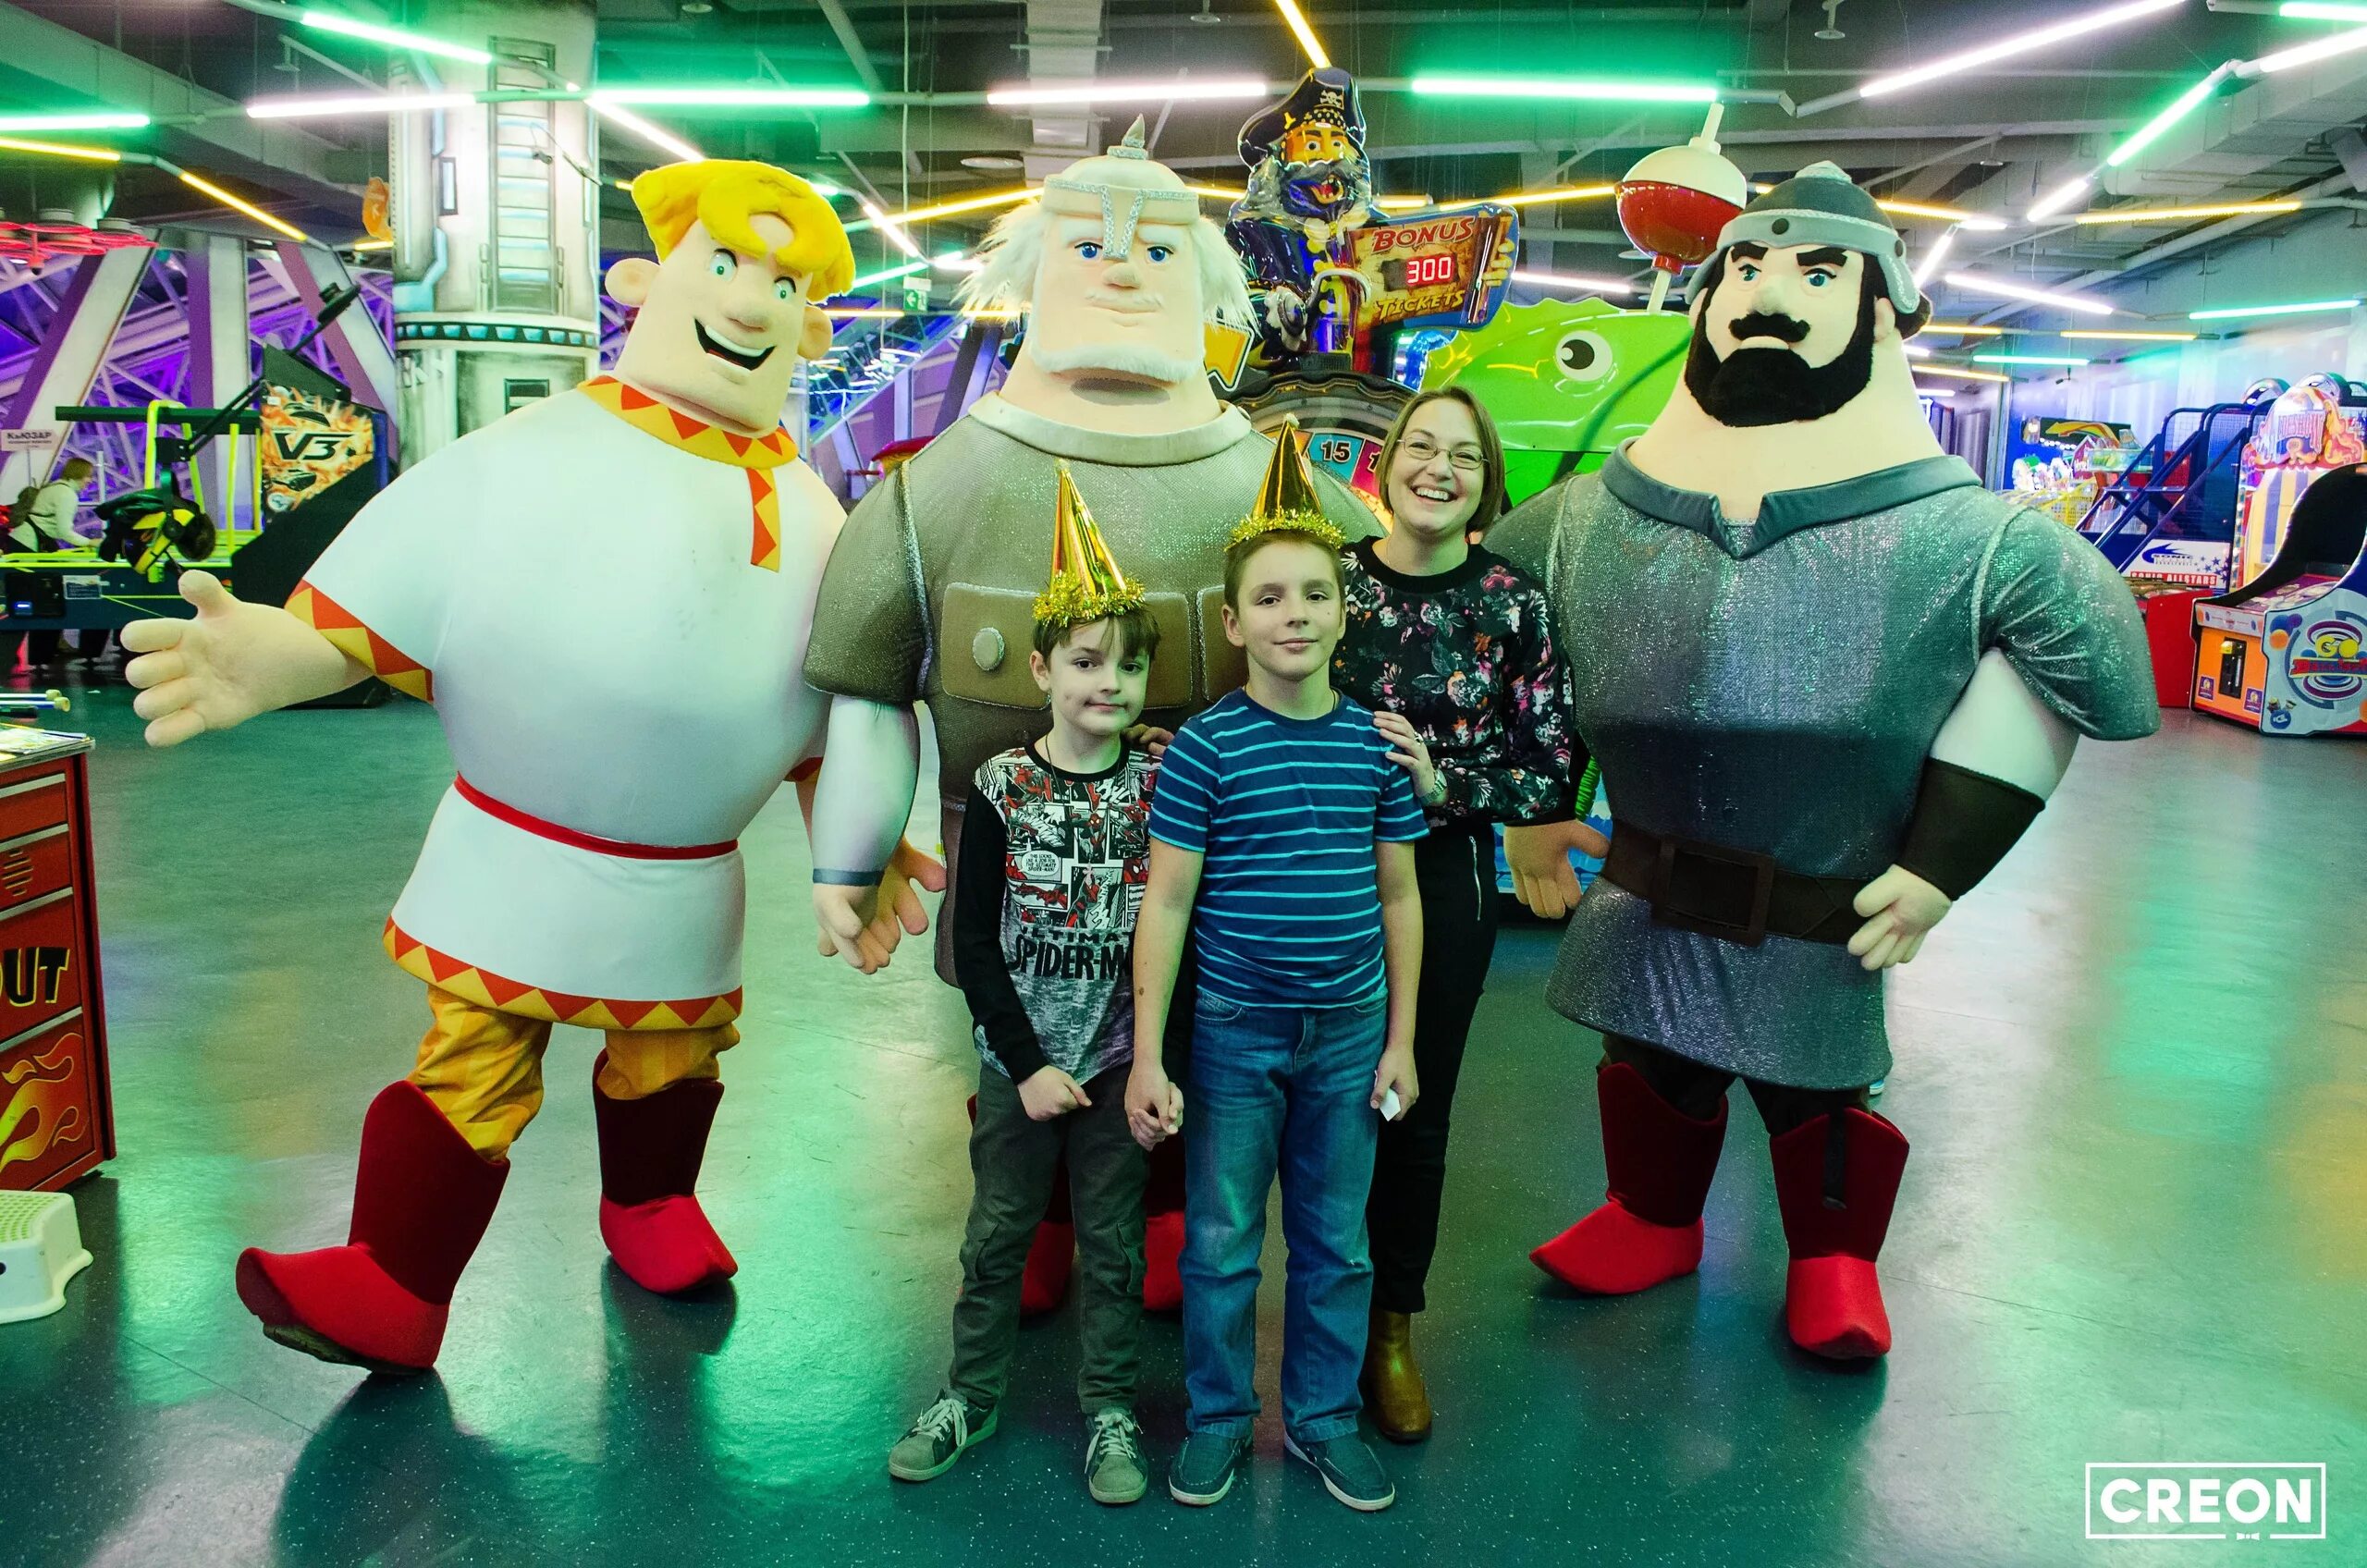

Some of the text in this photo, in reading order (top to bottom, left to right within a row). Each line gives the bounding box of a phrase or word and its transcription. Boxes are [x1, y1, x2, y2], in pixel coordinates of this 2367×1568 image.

[1371, 215, 1476, 254] BONUS
[1406, 256, 1452, 284] 300
[1376, 289, 1466, 321] TICKETS
[274, 432, 356, 460] V3
[1321, 439, 1351, 463] 15
[0, 947, 70, 1007] UT
